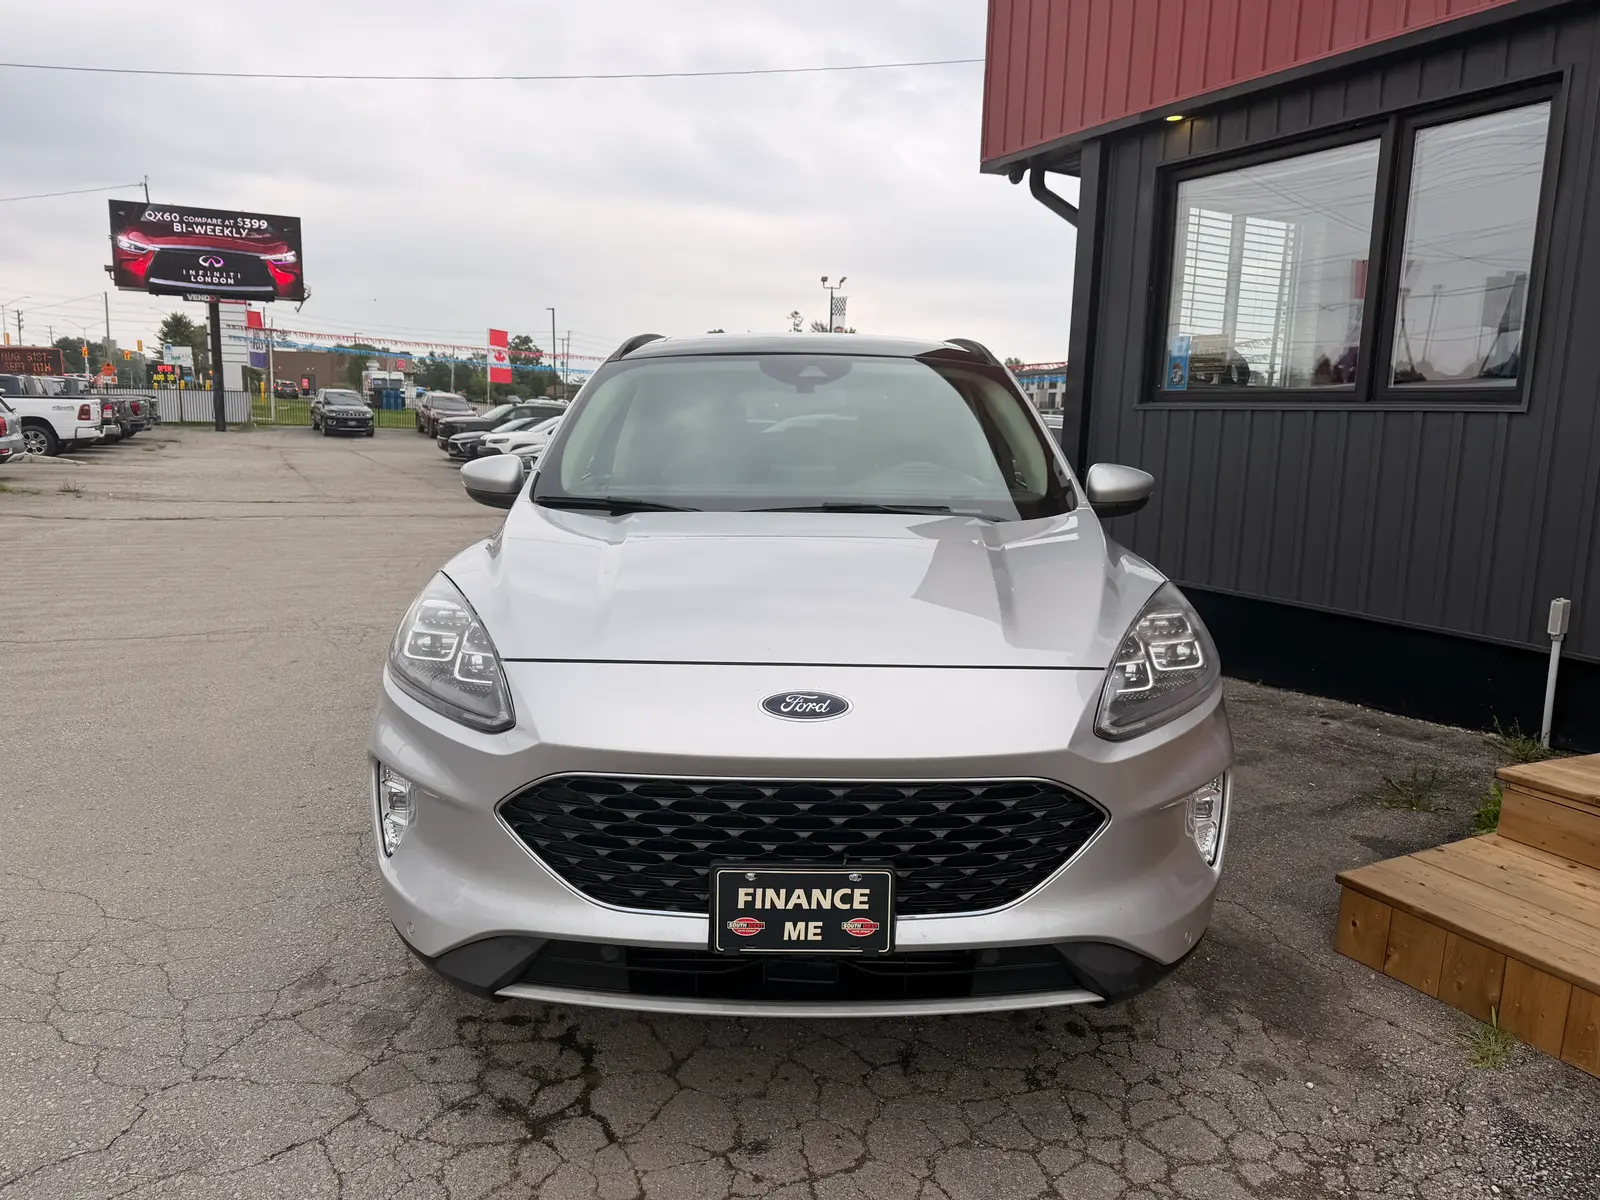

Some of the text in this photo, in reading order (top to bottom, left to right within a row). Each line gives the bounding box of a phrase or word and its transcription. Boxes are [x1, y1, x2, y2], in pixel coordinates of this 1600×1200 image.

[145, 210, 180, 222] QX60
[183, 215, 222, 225] COMPARE
[237, 217, 268, 229] $399
[173, 222, 248, 238] BI-WEEKLY
[183, 268, 241, 279] INFINITI
[191, 275, 235, 285] LONDON
[1, 351, 20, 361] AUG
[780, 694, 830, 712] Ford
[737, 887, 871, 910] FINANCE
[783, 921, 824, 941] ME
